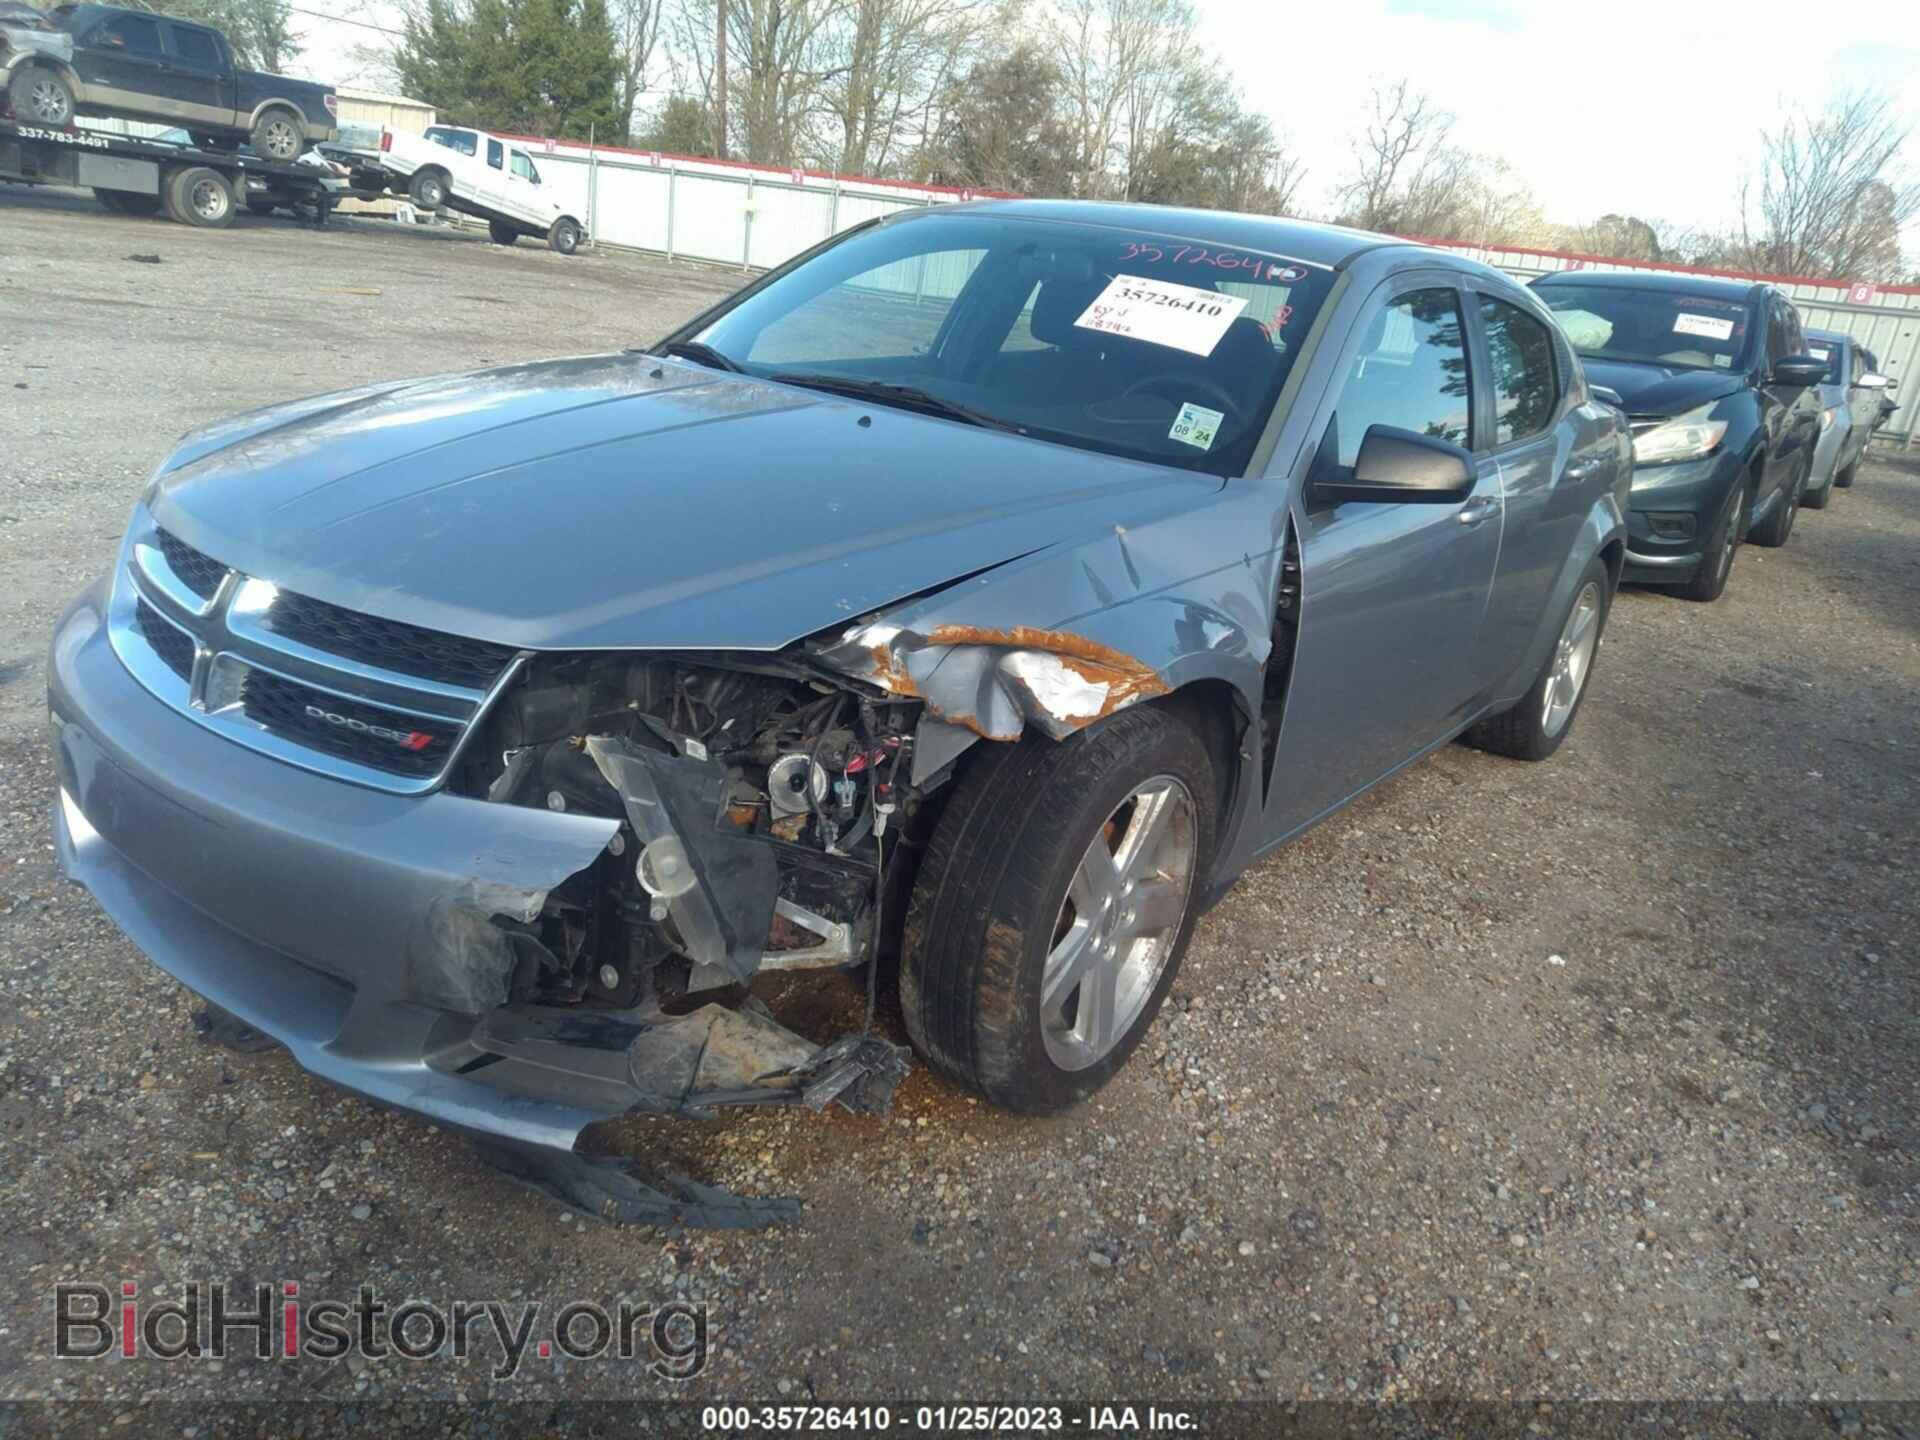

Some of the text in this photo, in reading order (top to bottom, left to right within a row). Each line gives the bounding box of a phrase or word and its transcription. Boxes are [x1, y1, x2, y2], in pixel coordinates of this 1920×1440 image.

[17, 126, 110, 149] 337-783-4491
[1119, 242, 1309, 283] 35726410
[1114, 287, 1223, 318] 35726410
[1855, 286, 1868, 301] 8
[1174, 423, 1211, 442] 08 24
[305, 705, 414, 745] DODGE
